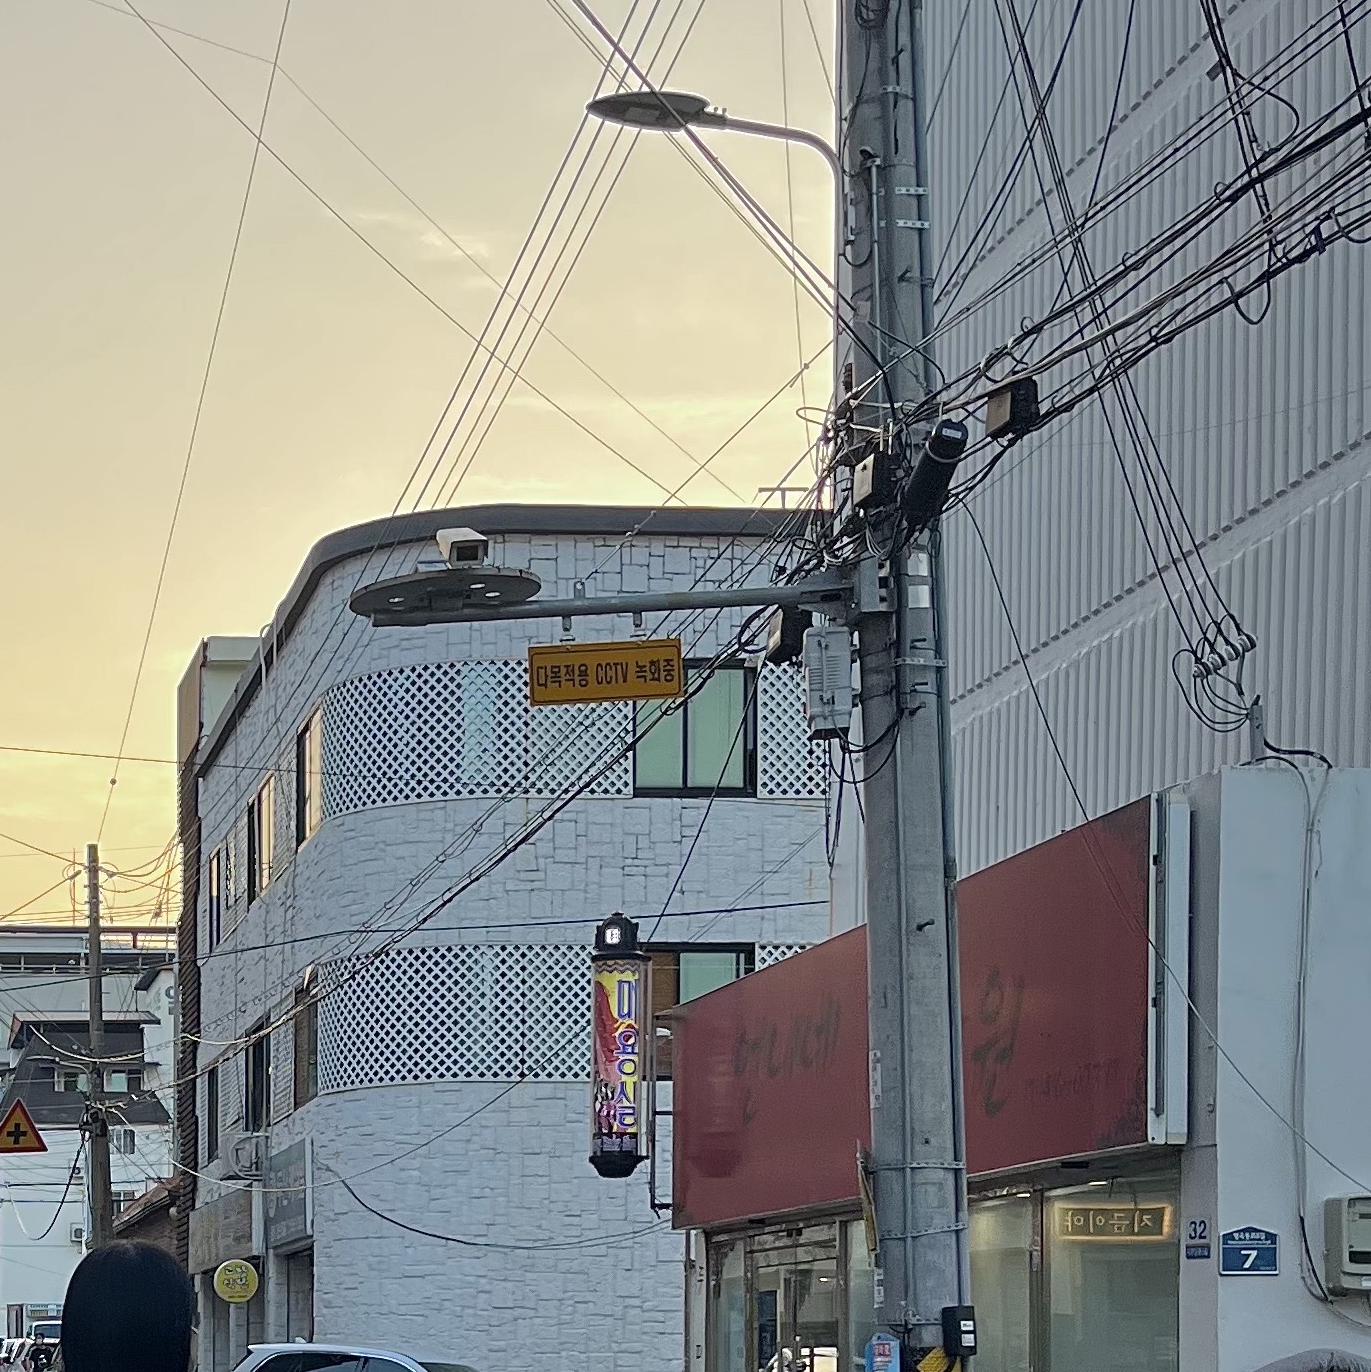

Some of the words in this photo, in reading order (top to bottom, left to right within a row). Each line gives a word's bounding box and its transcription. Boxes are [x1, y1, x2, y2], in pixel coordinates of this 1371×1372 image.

[536, 663, 589, 689] 다목적용
[595, 661, 628, 685] CCTV
[635, 658, 676, 684] 녹화중
[615, 978, 638, 1129] 미용실
[1188, 1219, 1207, 1240] 32
[1240, 1250, 1258, 1269] 7
